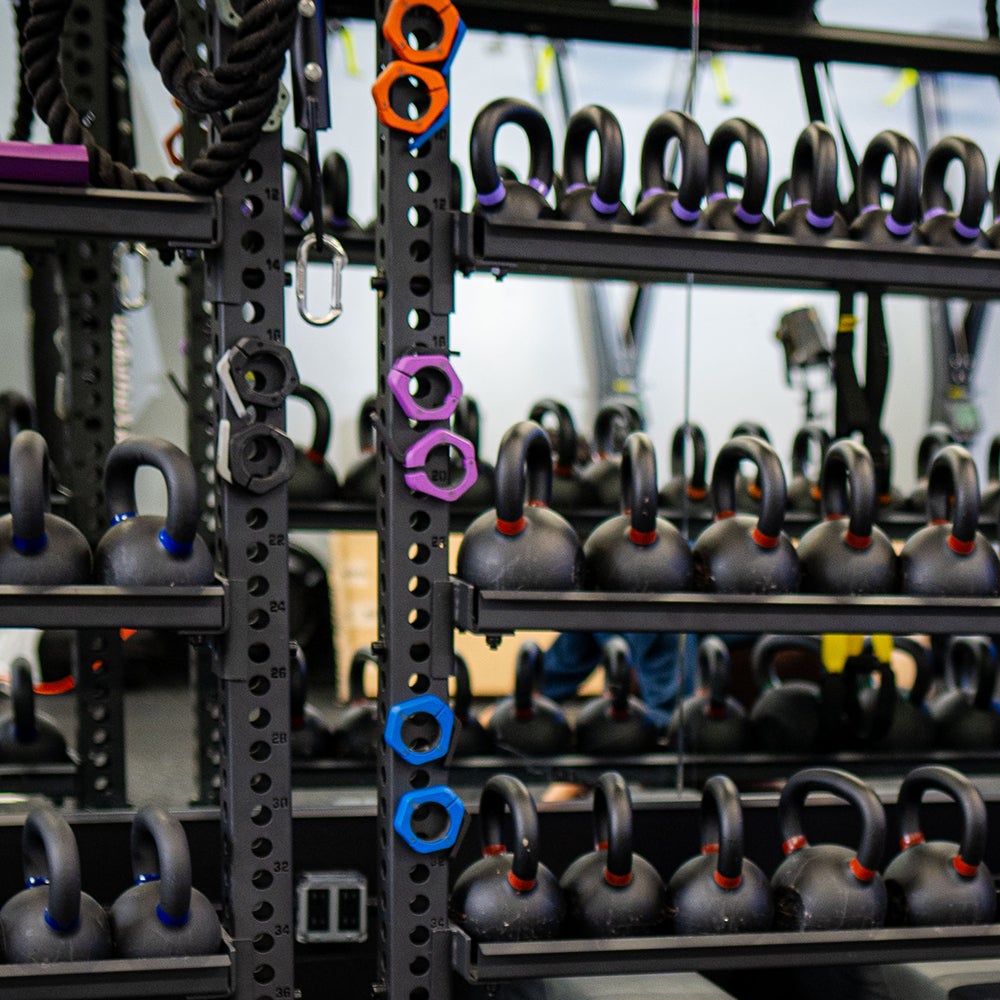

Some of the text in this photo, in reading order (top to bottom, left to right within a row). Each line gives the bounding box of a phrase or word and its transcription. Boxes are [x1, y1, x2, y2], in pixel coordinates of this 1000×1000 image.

[265, 258, 281, 271] 14
[269, 533, 285, 546] 22
[269, 601, 286, 612] 24
[270, 667, 287, 679] 26
[273, 861, 289, 873] 32
[274, 925, 290, 936] 34
[275, 988, 291, 999] 36
